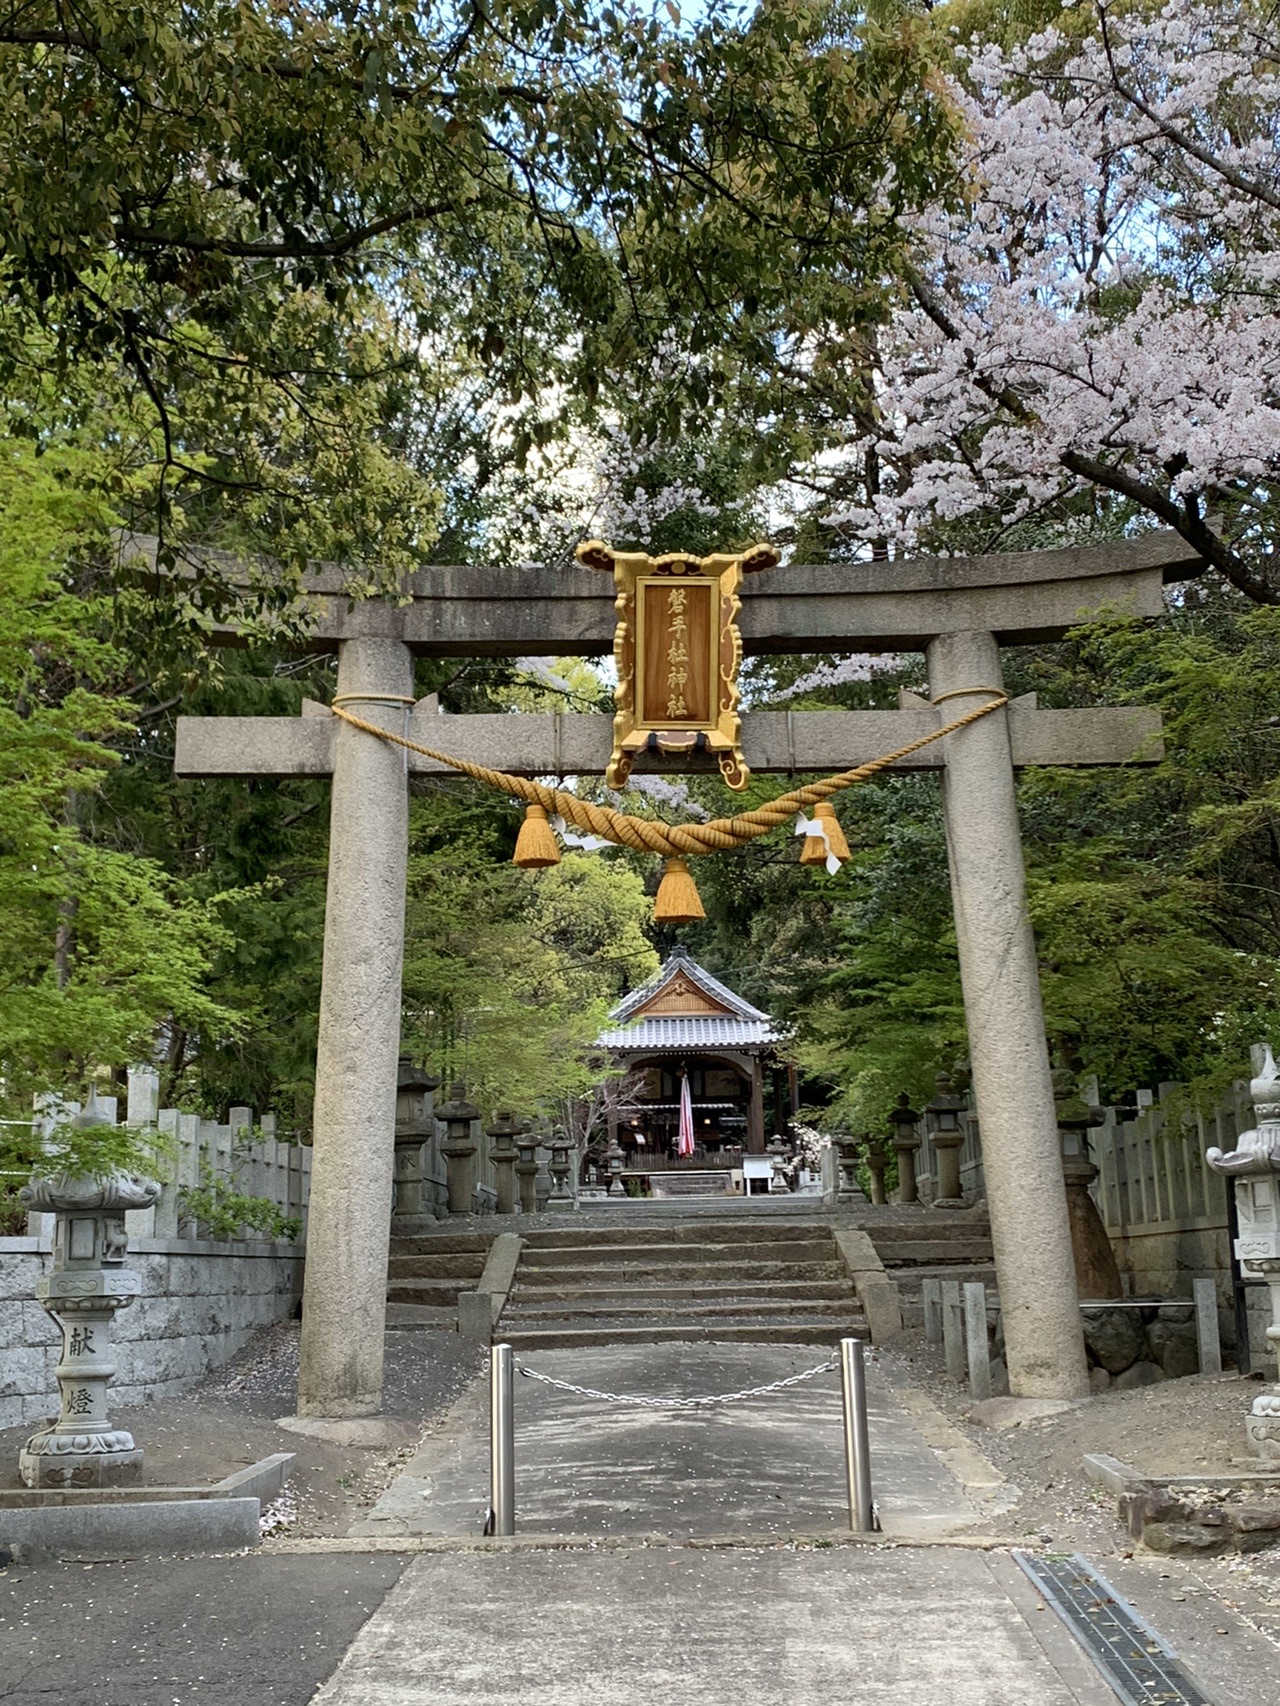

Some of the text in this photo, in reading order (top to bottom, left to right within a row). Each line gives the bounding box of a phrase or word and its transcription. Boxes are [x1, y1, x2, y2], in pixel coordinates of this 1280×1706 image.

[666, 588, 690, 718] 磐手杜神社
